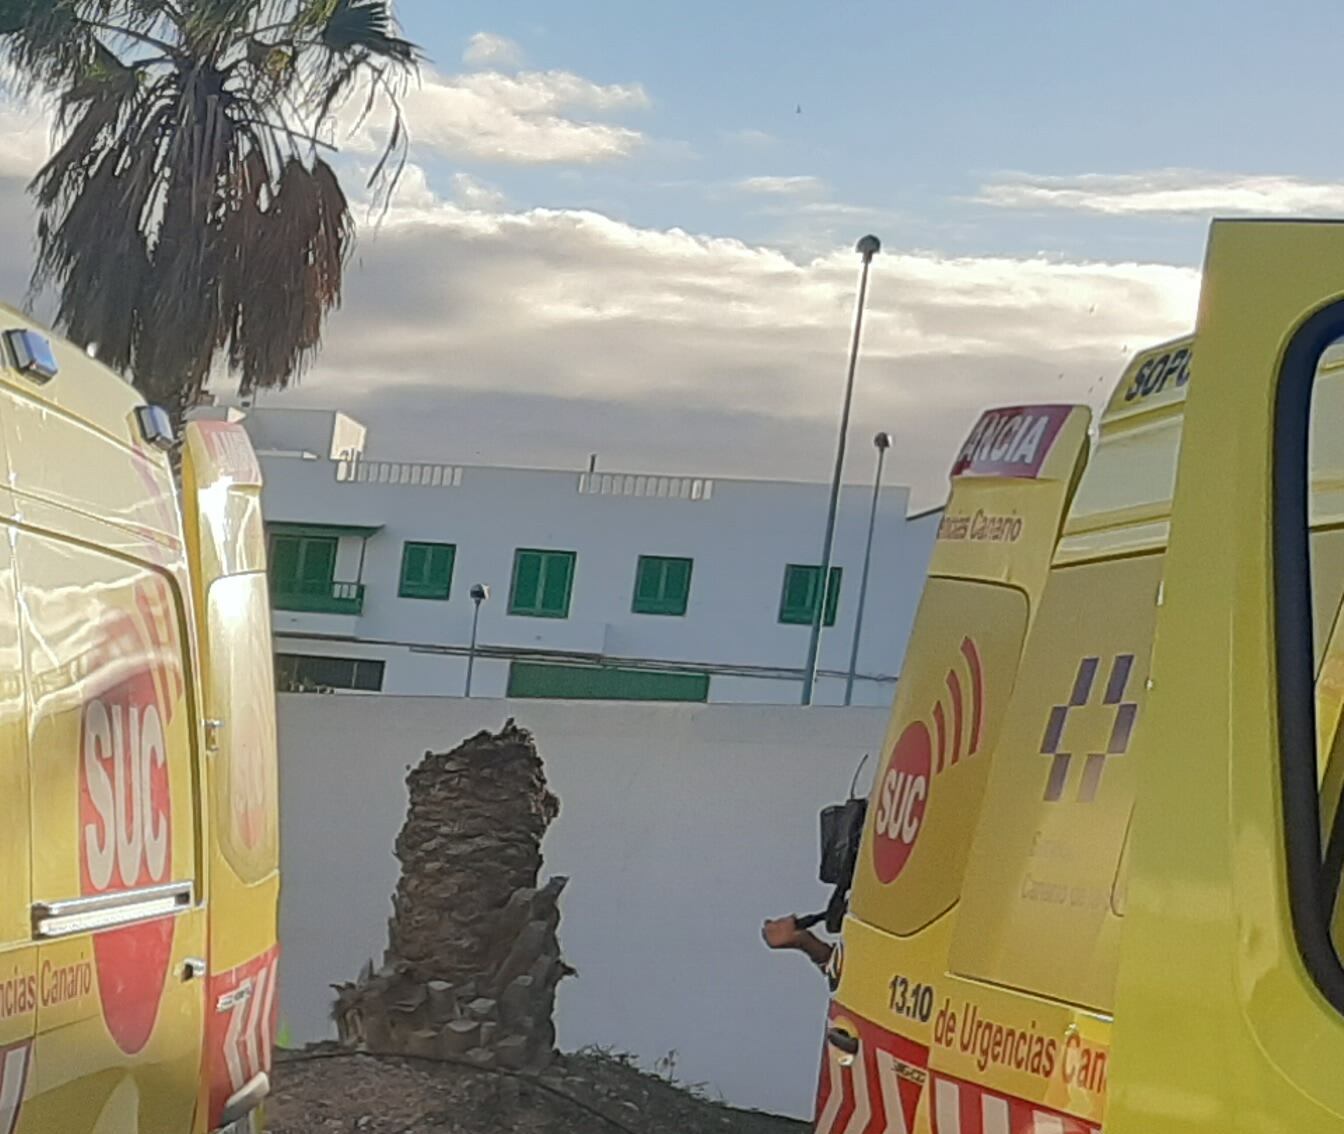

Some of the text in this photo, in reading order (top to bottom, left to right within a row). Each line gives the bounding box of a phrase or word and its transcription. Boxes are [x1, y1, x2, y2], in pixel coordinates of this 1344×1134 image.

[82, 698, 167, 890] SUC
[875, 768, 927, 845] SUC
[40, 951, 92, 1007] Canario
[888, 974, 934, 1024] 13.10
[933, 997, 1107, 1095] de Urgencias Can
